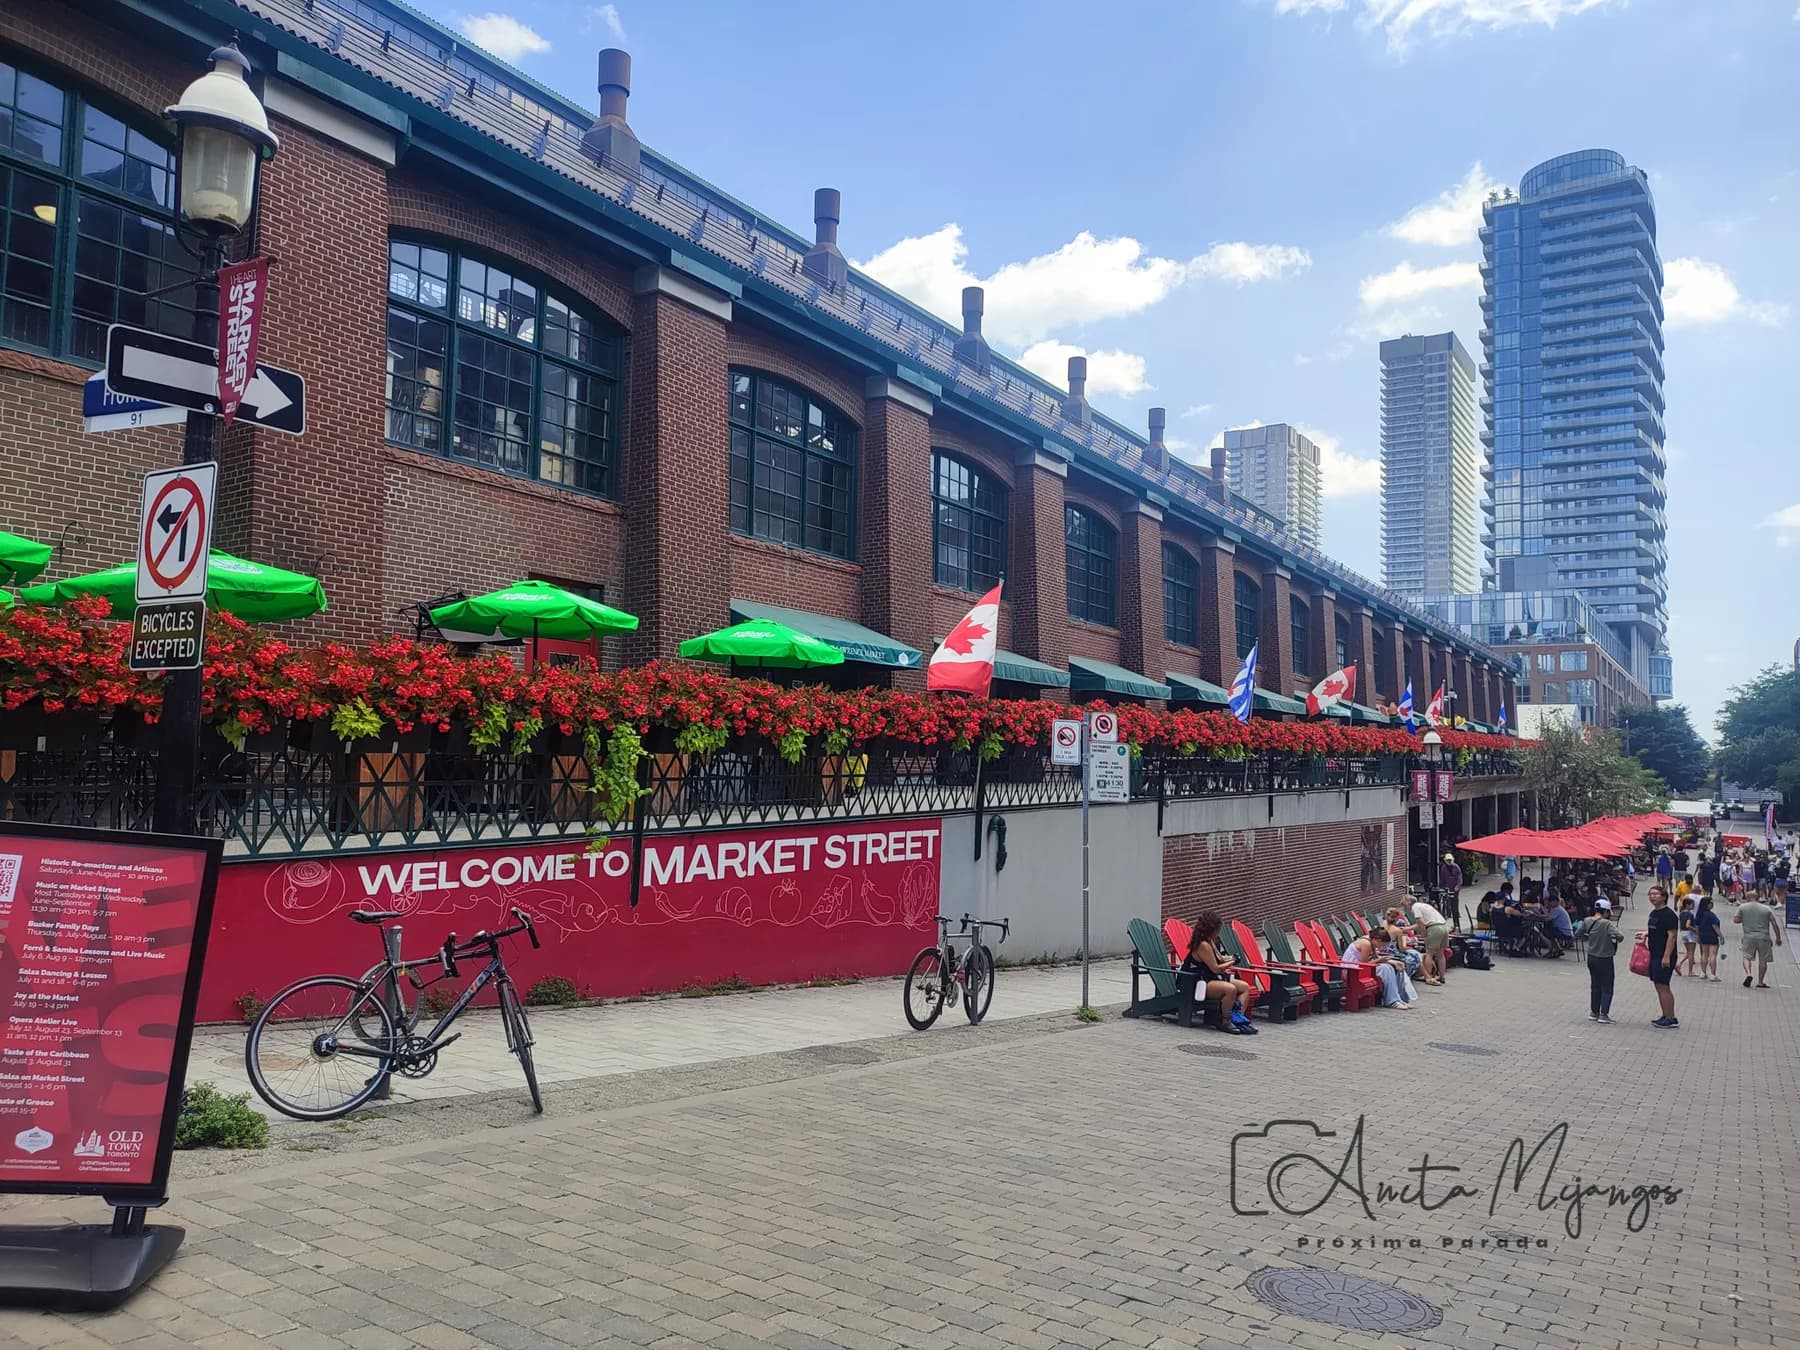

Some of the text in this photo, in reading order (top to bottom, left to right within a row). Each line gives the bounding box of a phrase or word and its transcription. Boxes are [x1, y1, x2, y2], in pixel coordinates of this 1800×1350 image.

[233, 269, 257, 284] HEART
[225, 284, 243, 388] STREET
[233, 280, 257, 396] MARKET
[141, 611, 195, 633] BICYCLES
[135, 638, 195, 659] EXCEPTED
[41, 858, 70, 866] Historic
[71, 860, 116, 870] Re-enactors
[133, 865, 163, 873] Artisans
[358, 828, 940, 895] WELCOME TO MARKET STREET
[76, 868, 120, 878] June-August
[36, 881, 58, 889] Music
[70, 884, 97, 892] Market
[98, 885, 121, 893] Street
[54, 890, 85, 899] Tuesdays
[32, 897, 92, 907] June-September
[27, 920, 100, 932] Busker Family Days
[65, 931, 107, 940] July-August
[21, 952, 36, 960] July
[45, 954, 61, 962] Aug
[51, 946, 79, 954] Samba
[79, 947, 110, 956] Lessons
[126, 950, 142, 958] Live
[143, 951, 166, 959] Music
[18, 967, 40, 975] Salsa
[40, 969, 73, 978] Dancing
[80, 971, 108, 979] Lesson
[17, 976, 32, 984] July
[14, 992, 27, 1001] Joy
[52, 994, 79, 1002] Market
[12, 1001, 27, 1009] July
[9, 1016, 78, 1026] Opera Atelier Live
[7, 1024, 22, 1032] July
[34, 1026, 61, 1034] August
[73, 1027, 113, 1036] September
[3, 1048, 25, 1056] Taste
[49, 1050, 90, 1059] Caribbean
[1, 1056, 27, 1065] August
[36, 1058, 62, 1066] August
[32, 1074, 60, 1082] Market
[60, 1075, 85, 1083] Street
[108, 1130, 144, 1143] OLD
[108, 1142, 142, 1151] TOWN
